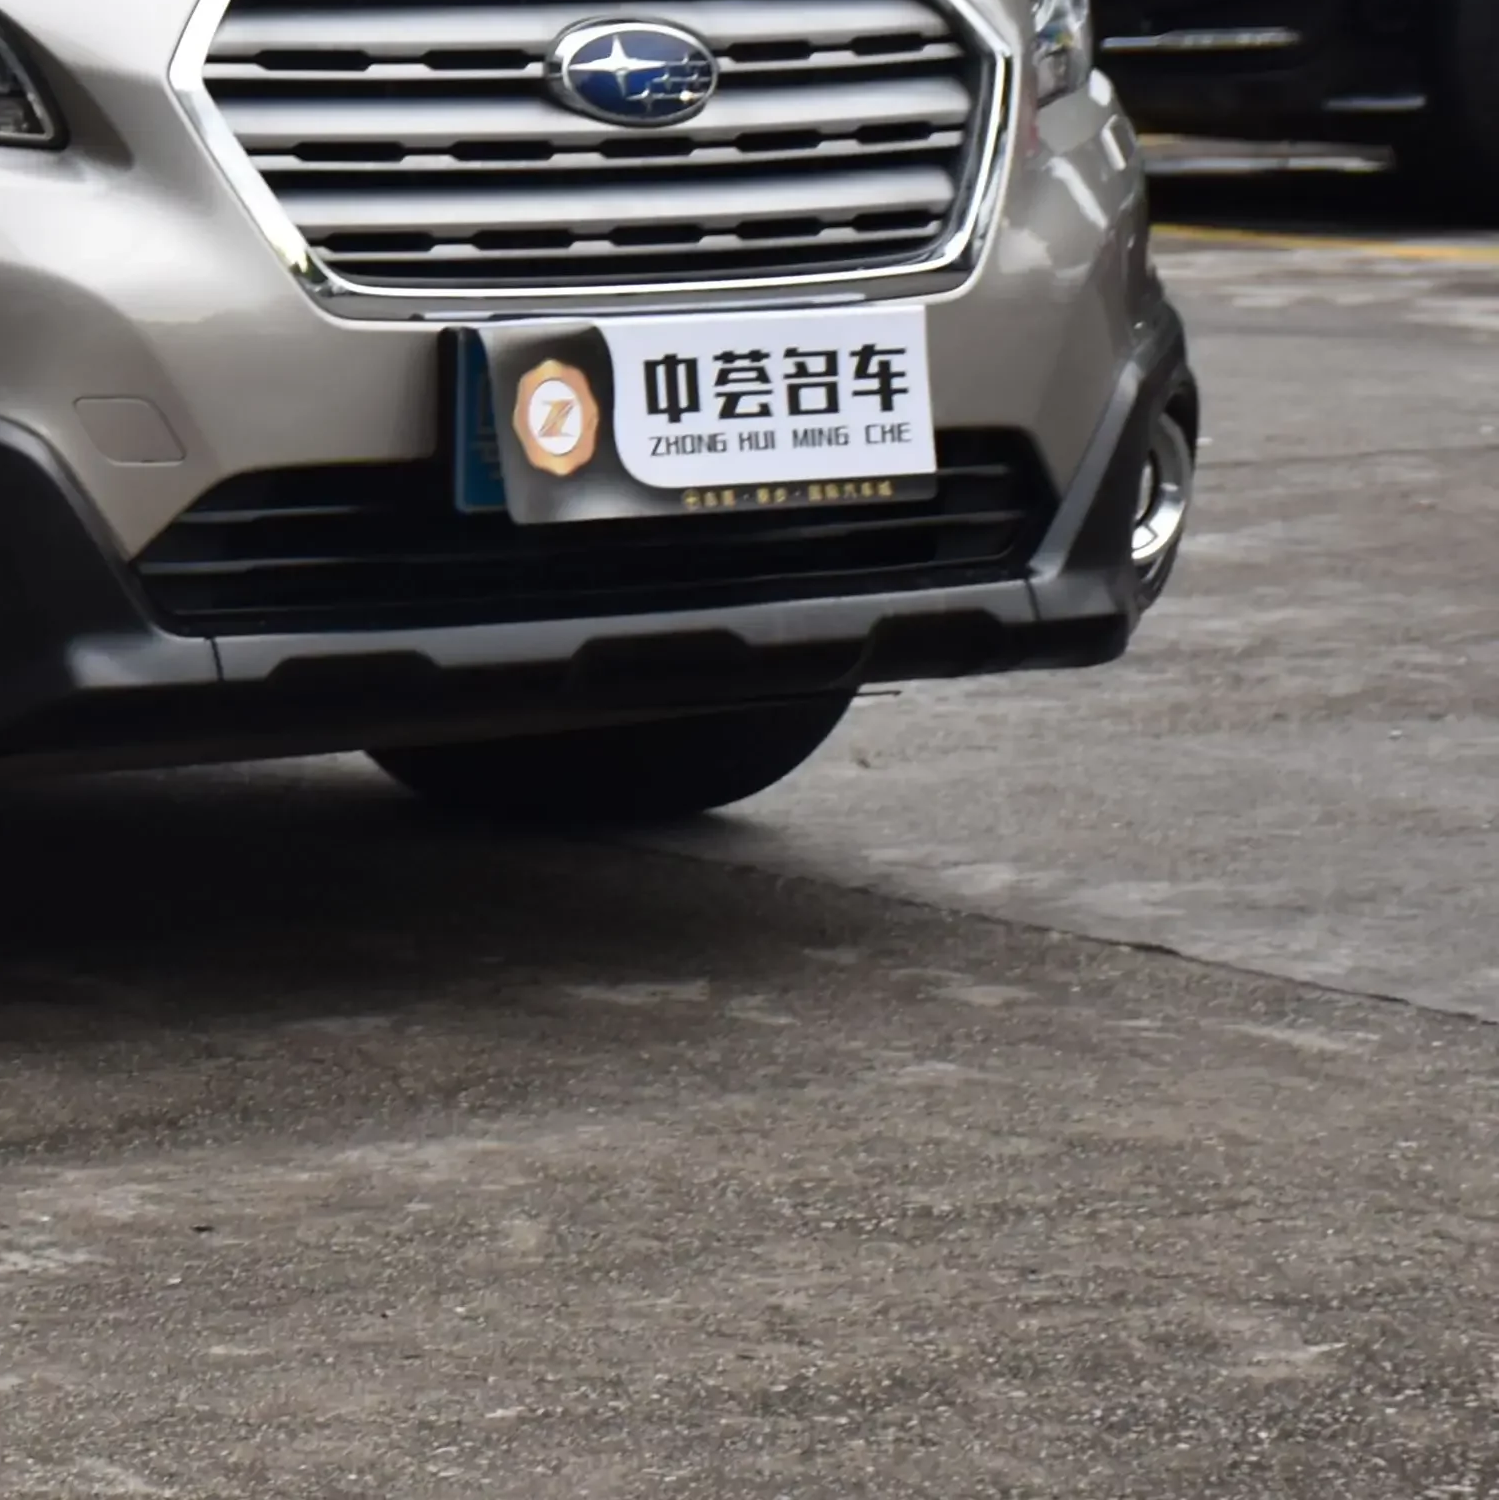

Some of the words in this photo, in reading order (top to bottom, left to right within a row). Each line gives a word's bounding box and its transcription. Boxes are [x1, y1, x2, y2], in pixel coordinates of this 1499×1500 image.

[644, 343, 909, 424] 中荟名车
[649, 431, 728, 458] ZHONG
[738, 429, 776, 452] HUI
[791, 424, 850, 449] MING
[864, 421, 913, 445] CHE
